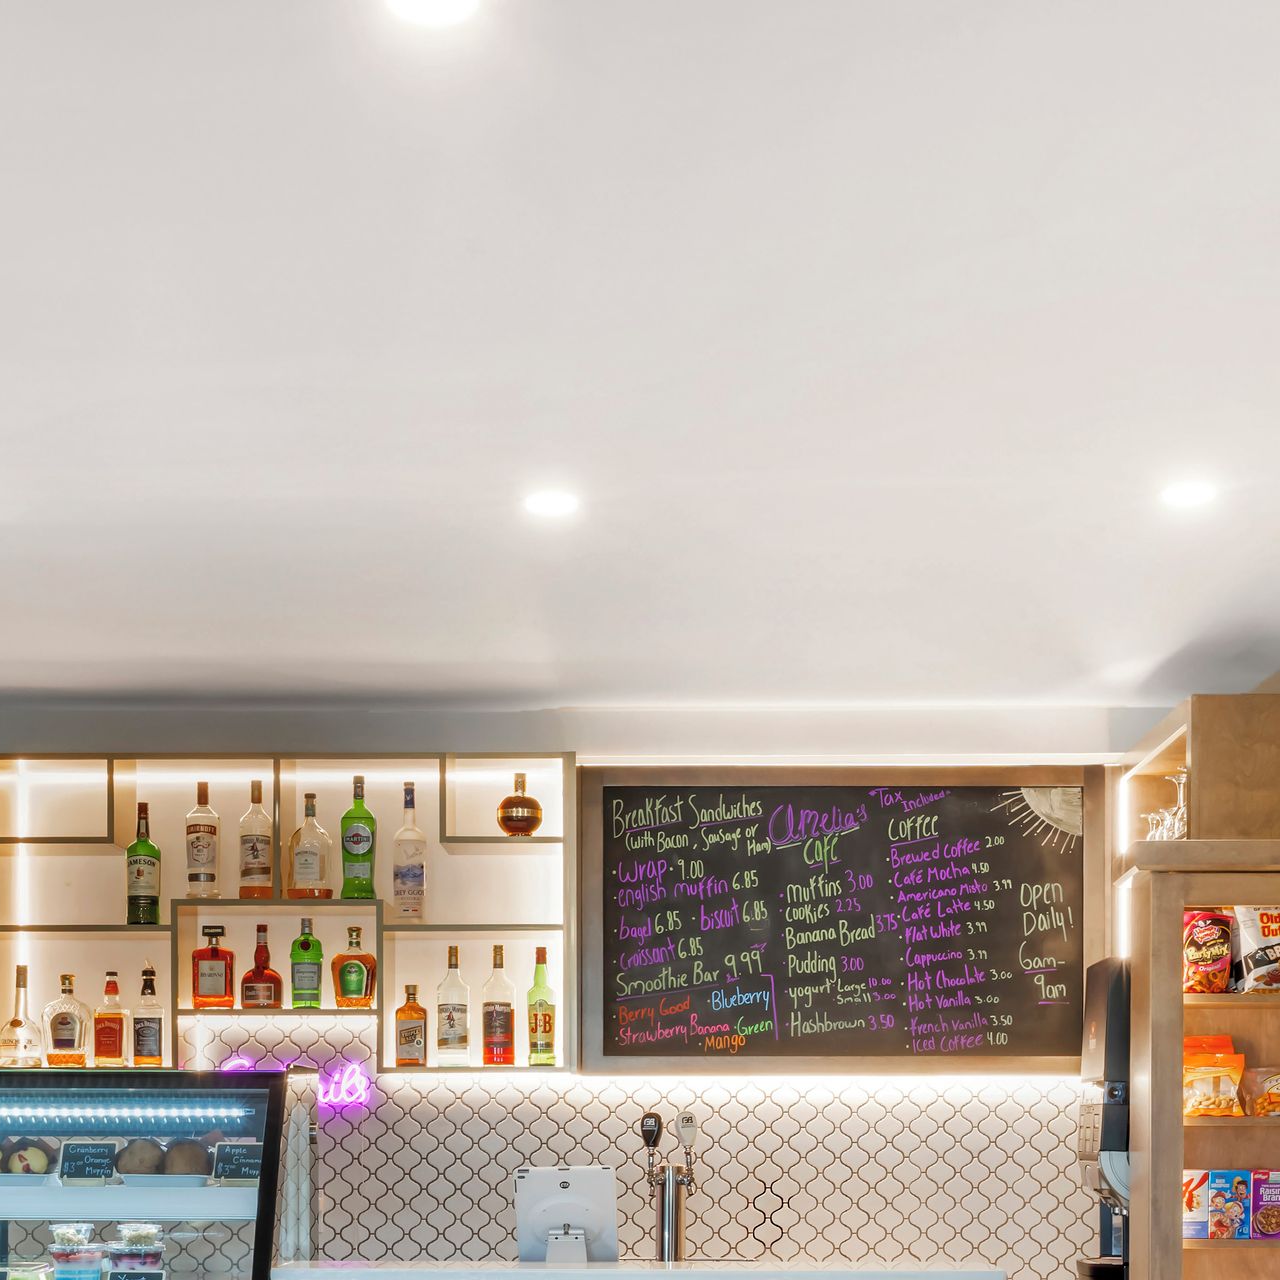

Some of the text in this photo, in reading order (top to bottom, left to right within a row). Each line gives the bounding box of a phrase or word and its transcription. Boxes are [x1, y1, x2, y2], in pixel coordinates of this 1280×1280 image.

[875, 787, 904, 808] Tax
[901, 789, 946, 813] Included
[689, 794, 763, 829] Sandwiches
[745, 823, 759, 838] or
[890, 836, 1006, 869] Brewed Coffee 2.00
[677, 859, 704, 880] 9.00
[844, 869, 874, 893] 3.00
[927, 861, 971, 883] Mocha
[971, 862, 990, 874] 4.50
[618, 869, 759, 911] english muffin 6.85
[897, 878, 1013, 904] Americano Misto 3.99
[1019, 882, 1064, 911] Open
[835, 897, 862, 912] 2.25
[937, 897, 972, 918] Latte
[973, 899, 996, 911] 4.50
[620, 897, 768, 946] bagel 6.85 biscuit 6.85
[785, 913, 899, 950] Banana Bread 3.75
[905, 919, 988, 945] Flat White 3.99
[1022, 906, 1074, 942] Daily!
[677, 936, 704, 959] 6.85
[905, 946, 963, 969] Cappuccino
[616, 950, 762, 997] Smoothie Bar 9.99
[788, 950, 865, 984] Pudding 3.00
[907, 963, 1014, 992] Hot Chocolate 3.00
[711, 986, 770, 1011] Blueberry
[788, 977, 893, 1010] yogurt Large 10.00
[836, 991, 898, 1005] Small 3.00
[1033, 974, 1067, 999] 9am
[618, 994, 691, 1027] Berry Good
[908, 990, 1001, 1013] Hot Vanilla 3.00
[618, 1013, 730, 1046] Strawberry Banana
[736, 1016, 774, 1035] Green
[790, 1011, 896, 1038] Hashbrown 3.50
[910, 1012, 1014, 1036] French Vanilla 3.50
[704, 1034, 747, 1054] Mango
[912, 1036, 936, 1054] Iced
[986, 1031, 1009, 1046] 4.00
[225, 1145, 248, 1155] Apple
[1263, 1193, 1280, 1201] Bran
